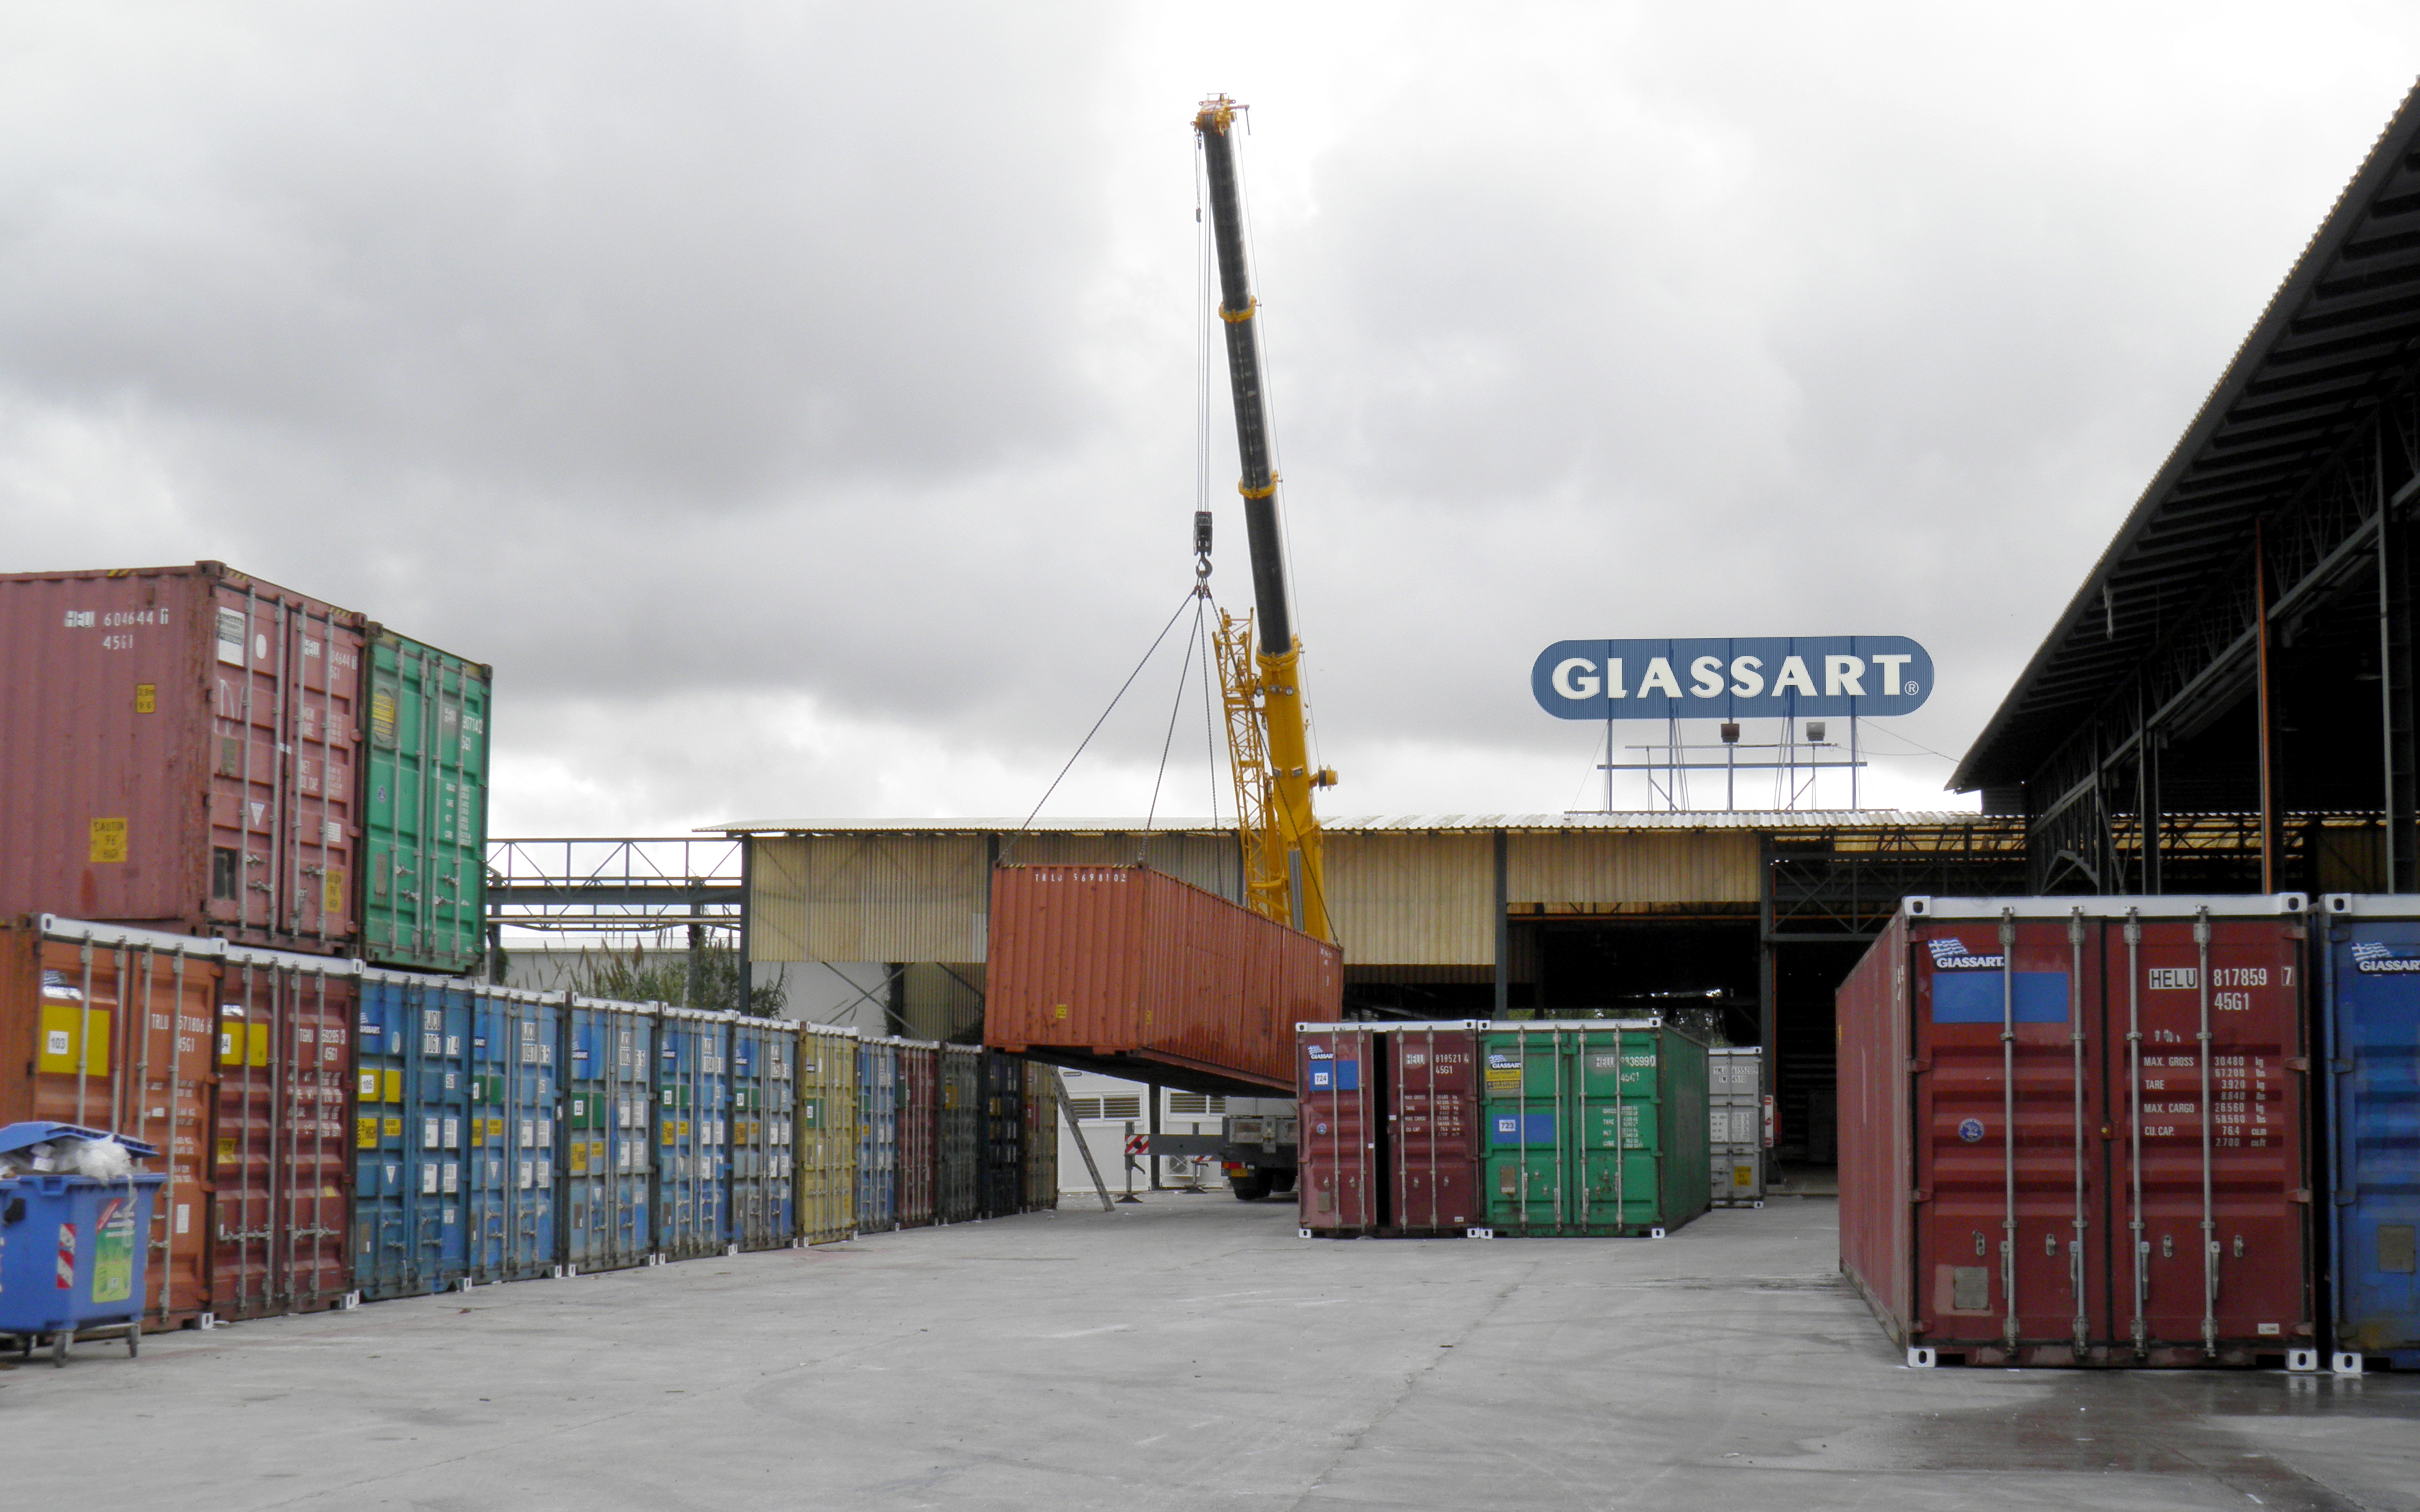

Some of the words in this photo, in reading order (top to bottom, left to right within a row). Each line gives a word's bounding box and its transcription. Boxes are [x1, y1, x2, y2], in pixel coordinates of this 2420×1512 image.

[104, 611, 154, 627] 604644
[1552, 654, 1911, 700] GLASSART
[1936, 956, 2003, 968] GLASSART
[2359, 960, 2420, 971] GLASSAR
[2151, 970, 2196, 987] HELU
[2213, 968, 2266, 986] 817859
[2284, 967, 2292, 985] 7
[2214, 993, 2249, 1010] 45G1
[51, 1038, 65, 1049] 103
[2144, 1057, 2164, 1066] MAX.
[2168, 1057, 2194, 1066] GROSS
[2255, 1057, 2264, 1068] kg
[2145, 1080, 2164, 1089] TARE
[2256, 1080, 2265, 1091] kg
[2168, 1104, 2194, 1113] CARGO
[2256, 1103, 2264, 1114] kg
[2222, 1126, 2240, 1136] 76.4
